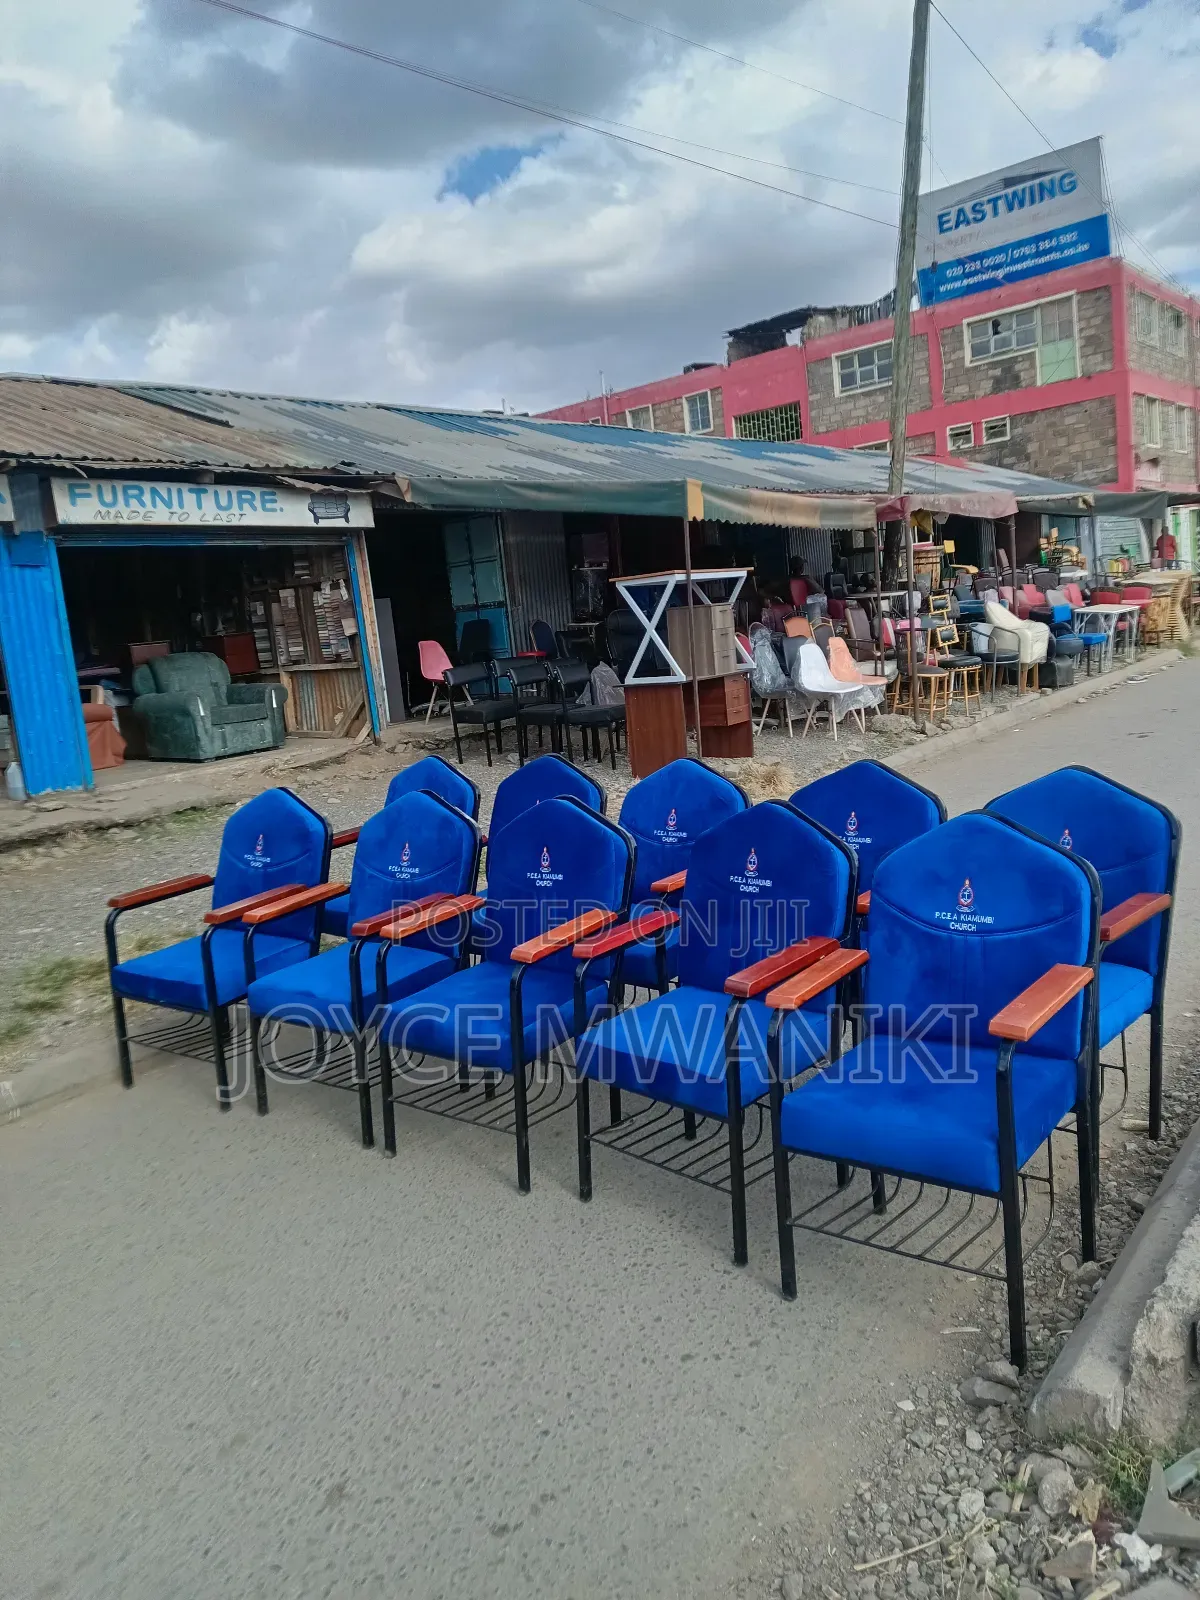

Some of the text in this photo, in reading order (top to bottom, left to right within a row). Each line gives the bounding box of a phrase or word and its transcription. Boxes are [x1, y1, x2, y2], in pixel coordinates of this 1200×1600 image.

[938, 170, 1079, 234] EASTWING
[946, 265, 963, 278] 020
[67, 482, 284, 513] FURNITURE.
[93, 509, 247, 523] MADE TO LAST
[960, 913, 995, 924] KIAMUMBI
[949, 921, 977, 932] CHURCH
